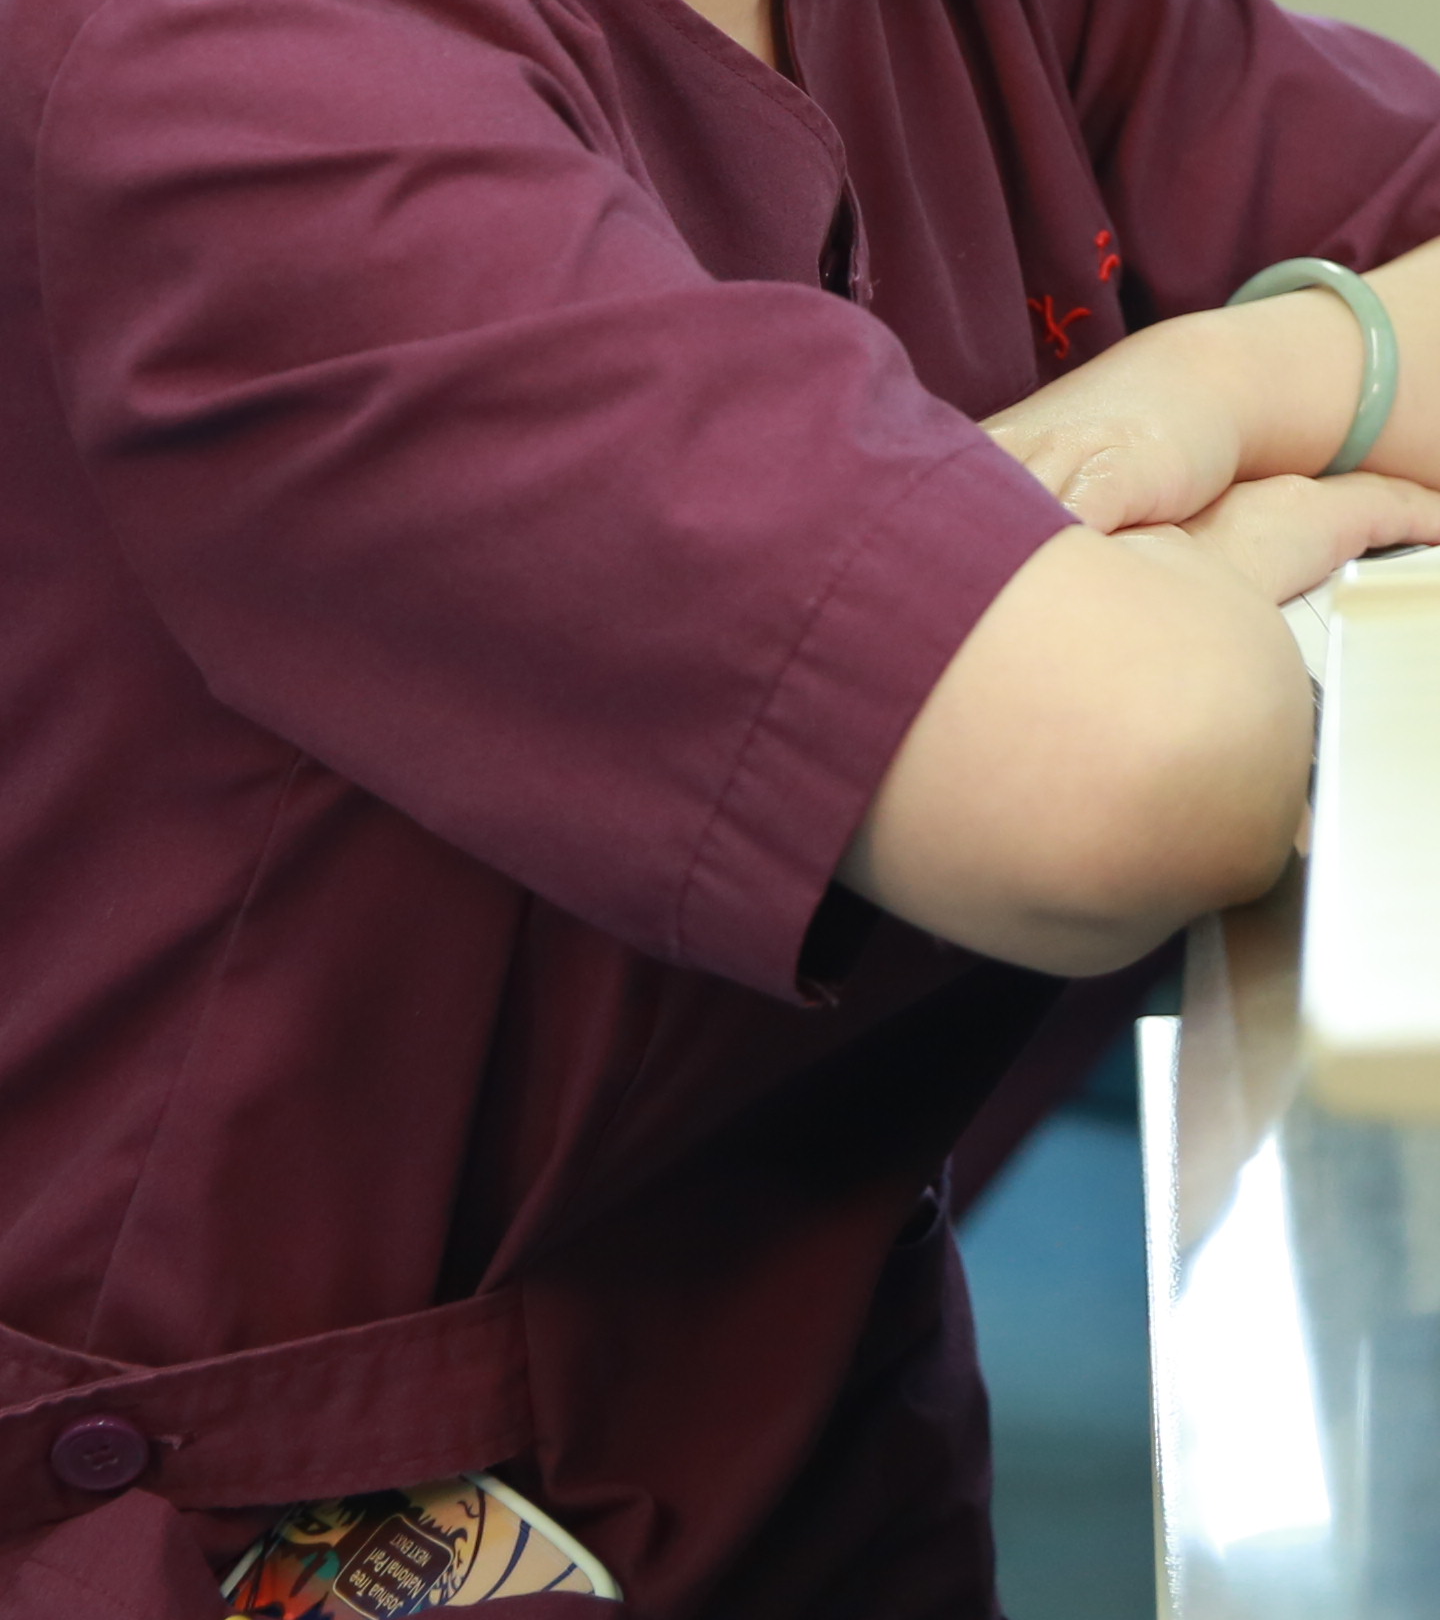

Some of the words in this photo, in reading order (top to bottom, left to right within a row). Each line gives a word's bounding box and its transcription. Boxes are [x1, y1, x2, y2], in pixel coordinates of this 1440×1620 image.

[407, 1544, 432, 1567] NEXT
[349, 1570, 371, 1597] Tree
[380, 1558, 426, 1599] National
[368, 1583, 405, 1618] Joshua
